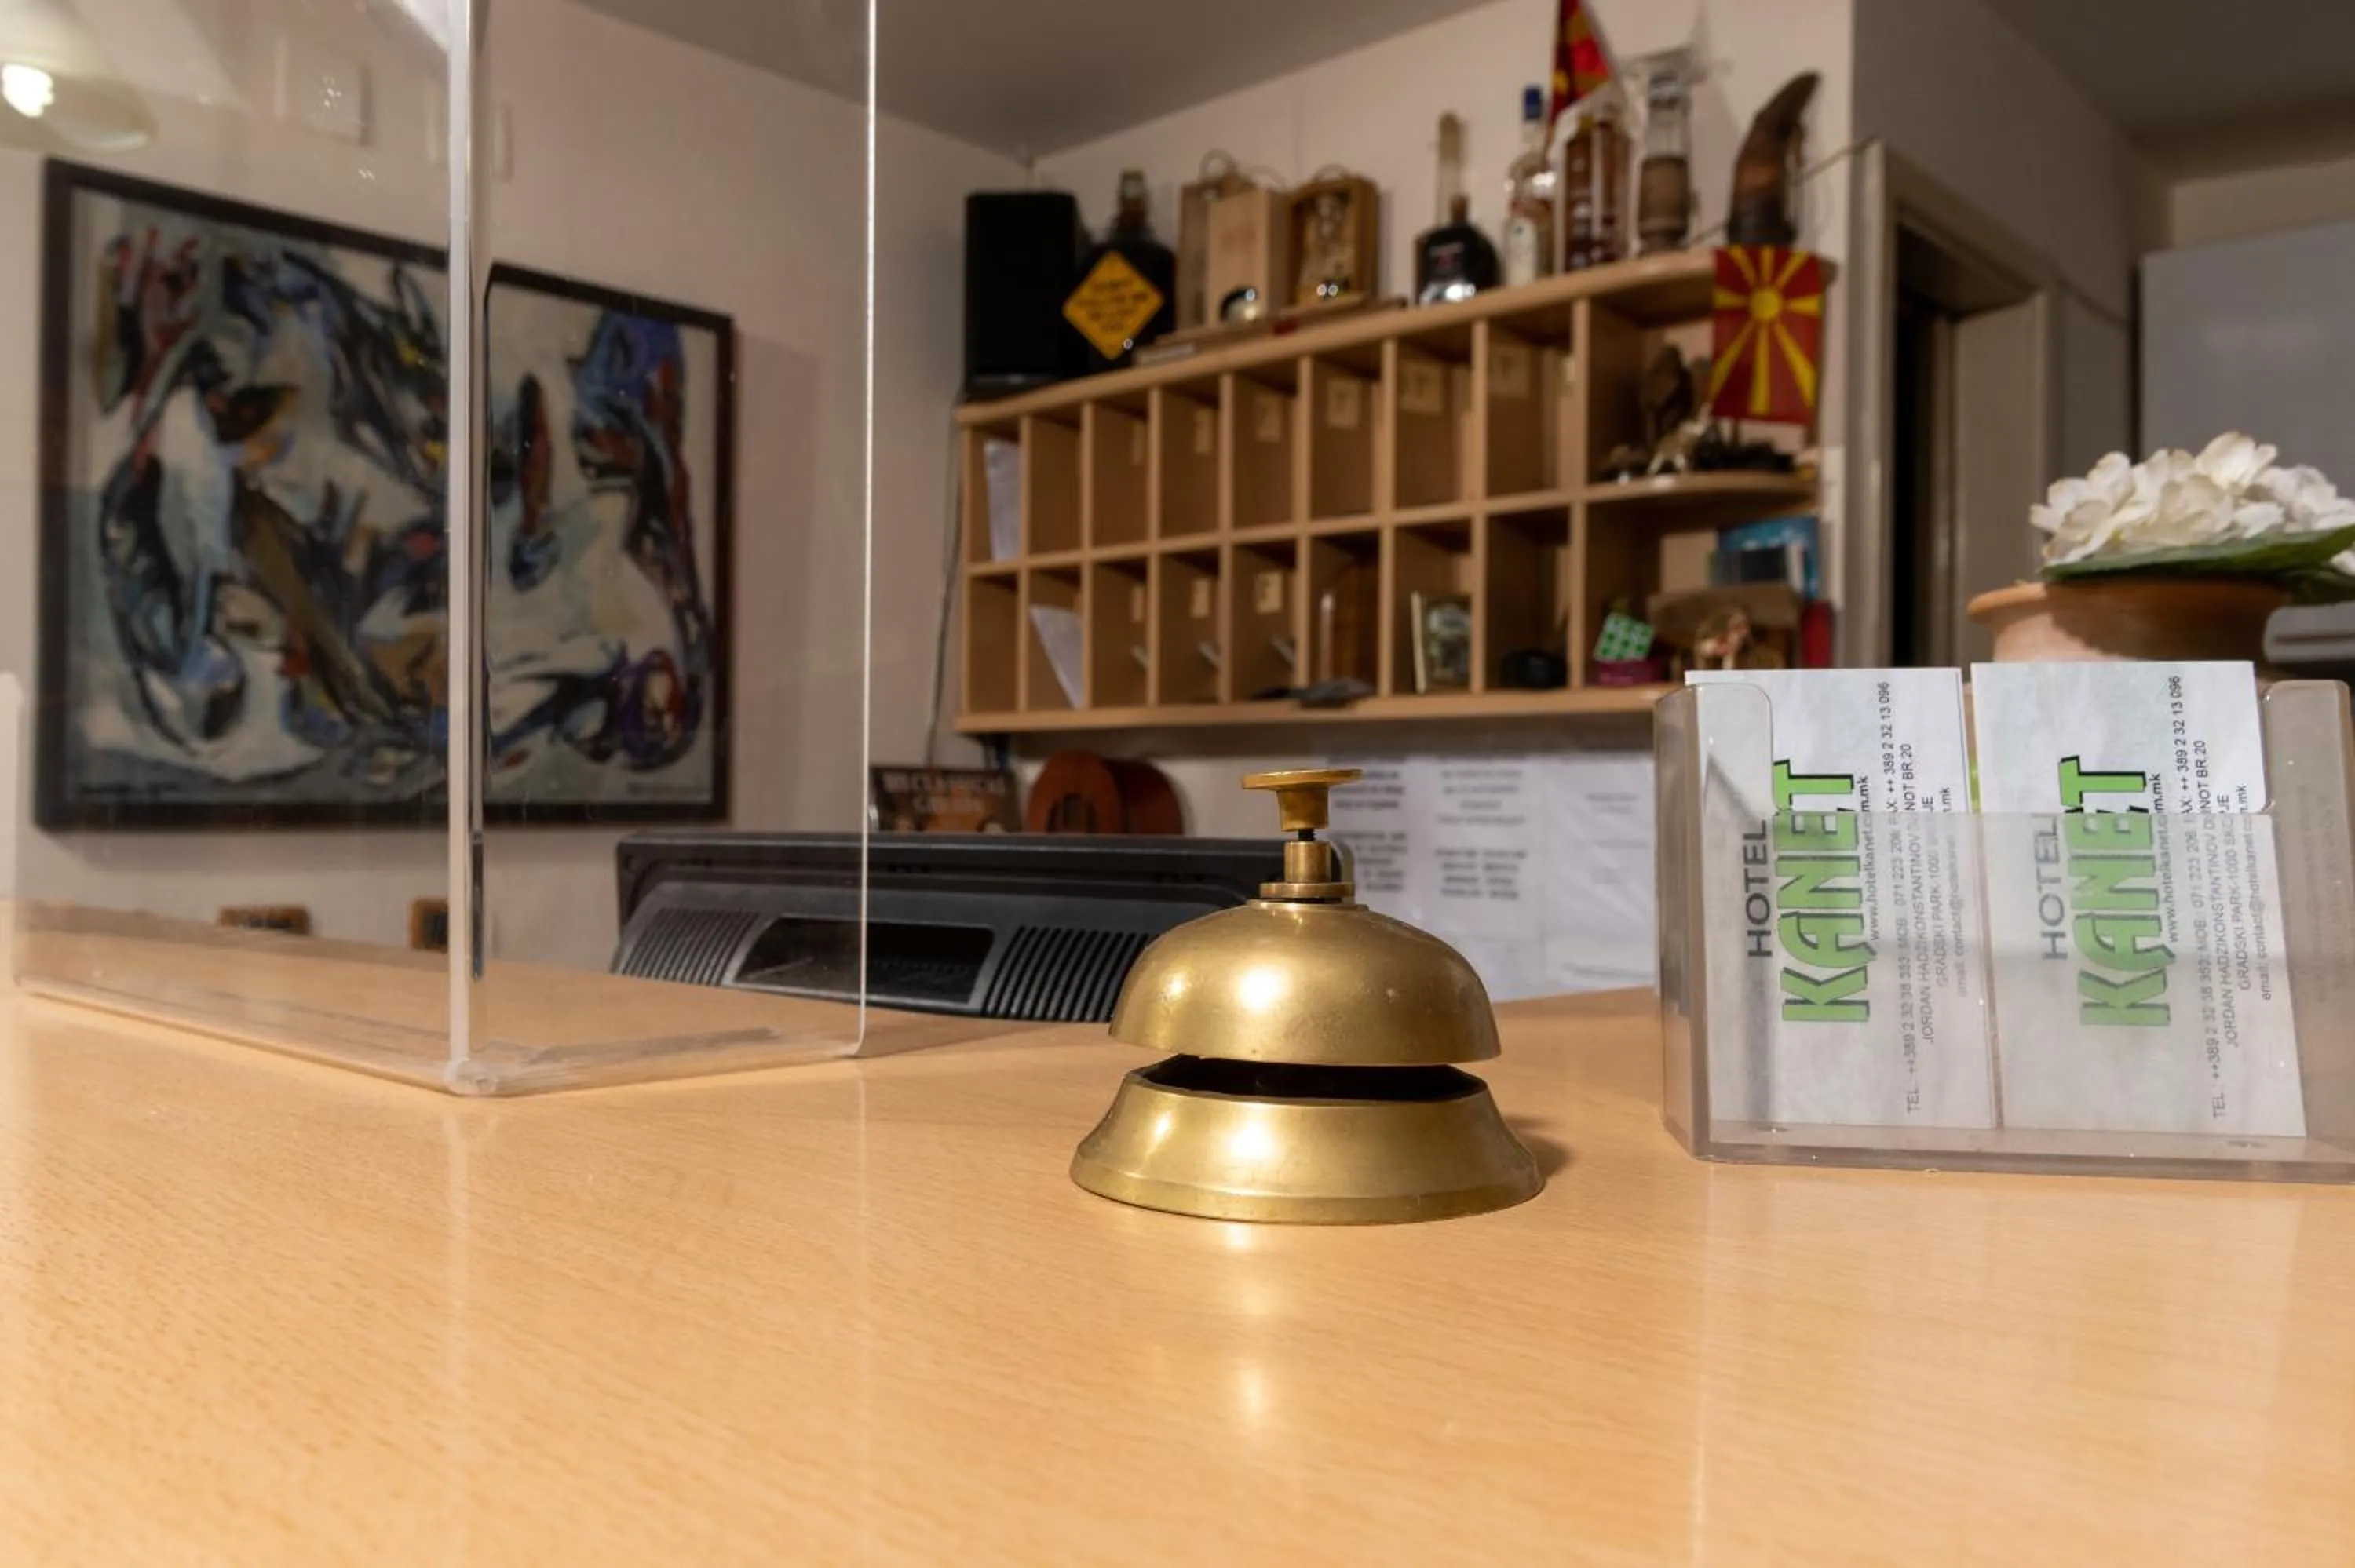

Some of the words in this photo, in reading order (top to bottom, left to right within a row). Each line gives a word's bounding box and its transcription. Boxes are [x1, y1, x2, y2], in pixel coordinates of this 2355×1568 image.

[2167, 675, 2181, 698] 096
[2173, 719, 2185, 735] 32
[2175, 749, 2189, 773] 389
[1742, 819, 1773, 958] HOTEL
[1771, 758, 1877, 1022] KANET
[2032, 815, 2068, 961] HOTEL
[2058, 754, 2175, 1026] KANET
[2233, 927, 2251, 990] GRADSKI
[1920, 985, 1934, 1044] JORDAN
[2221, 989, 2239, 1048] JORDAN
